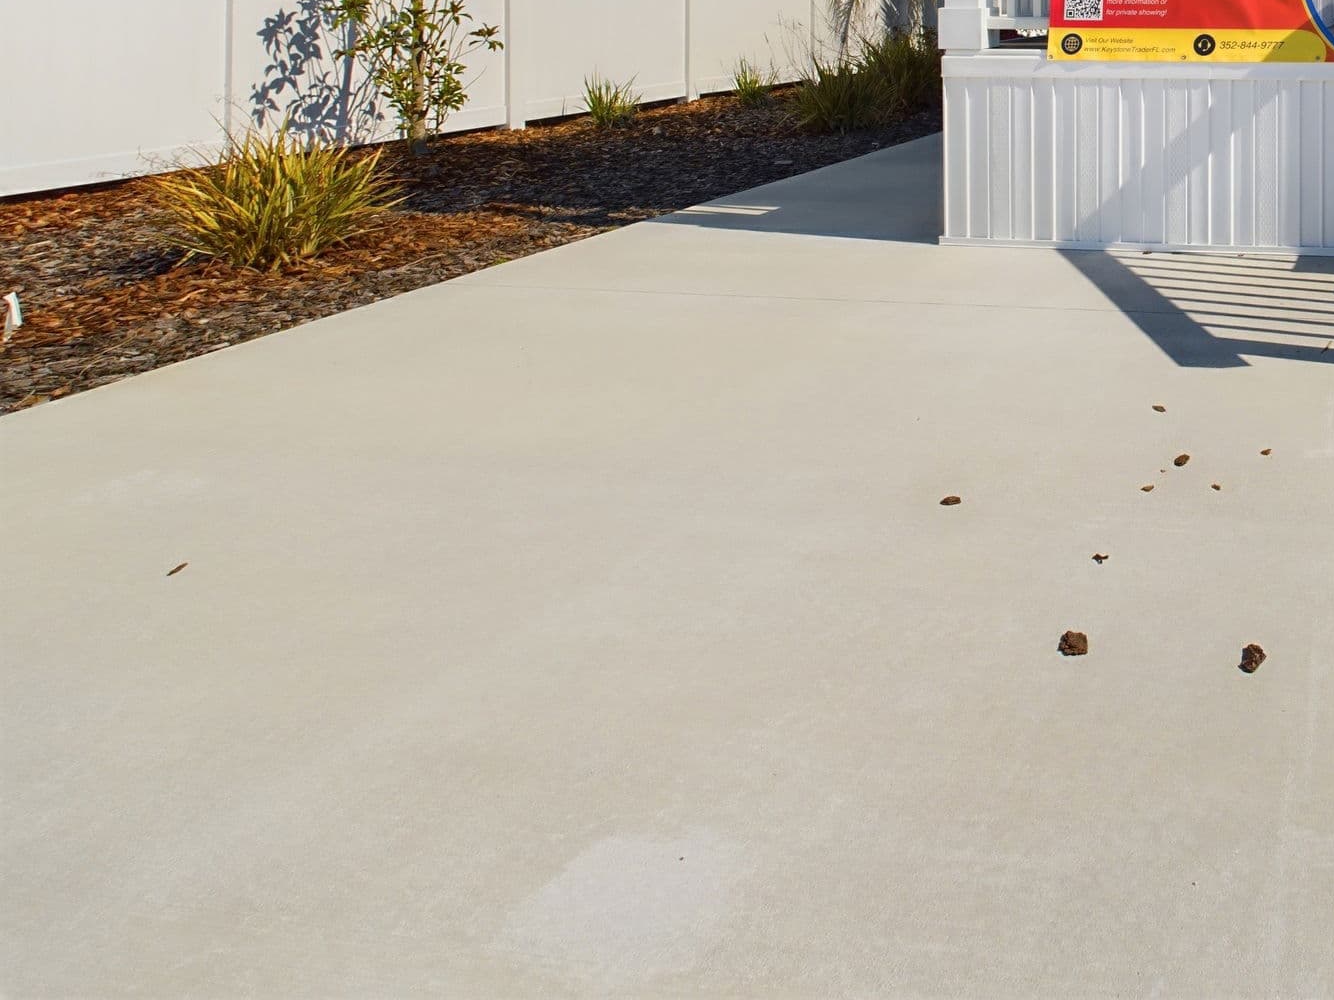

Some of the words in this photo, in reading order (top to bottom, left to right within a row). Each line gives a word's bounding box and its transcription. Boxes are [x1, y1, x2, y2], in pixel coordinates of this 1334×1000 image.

[1115, 9, 1138, 17] private
[1139, 9, 1168, 17] showing!
[1219, 41, 1284, 50] 352-844-9777
